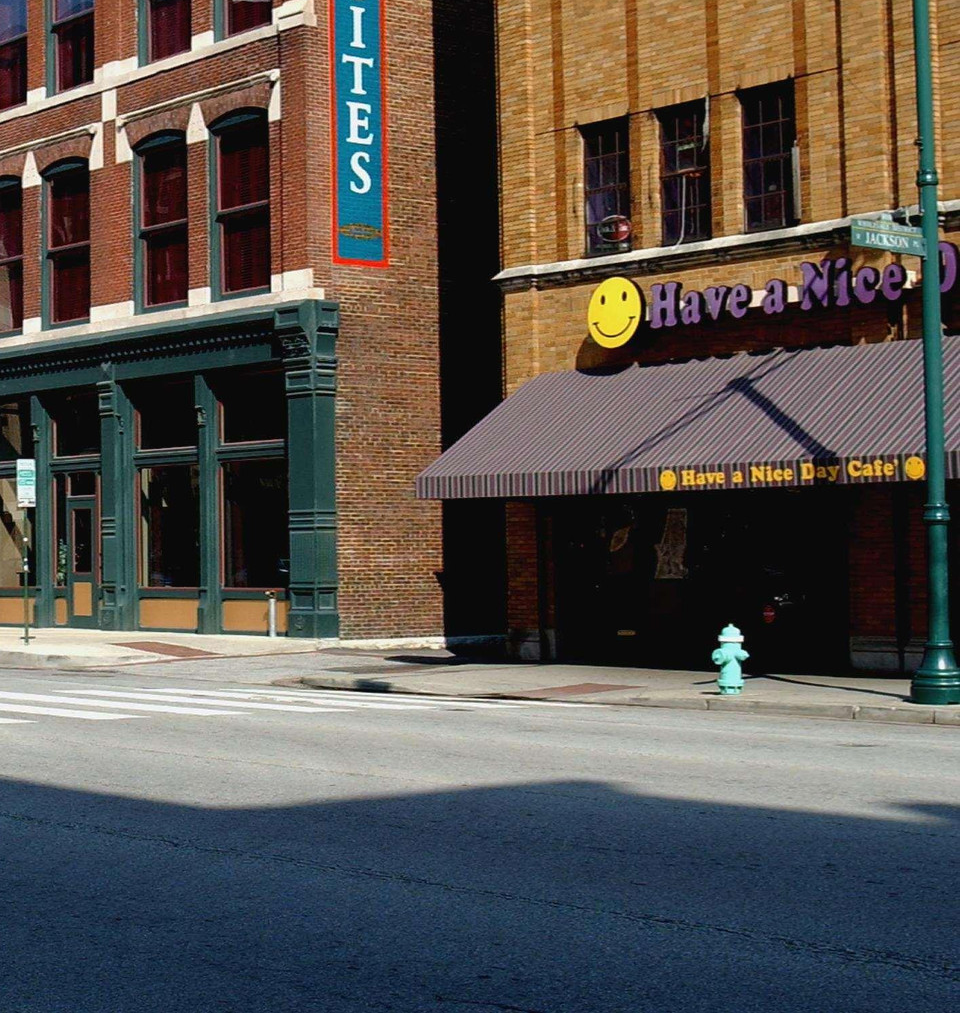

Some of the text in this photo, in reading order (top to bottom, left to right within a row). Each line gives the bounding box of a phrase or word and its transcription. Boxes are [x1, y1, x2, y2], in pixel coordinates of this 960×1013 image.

[865, 231, 909, 248] JACKSON
[650, 280, 750, 329] Have
[763, 278, 785, 315] a
[800, 257, 905, 311] Nice
[681, 469, 725, 486] Have
[732, 471, 743, 483] a
[750, 465, 794, 483] Nice
[801, 462, 840, 481] Day
